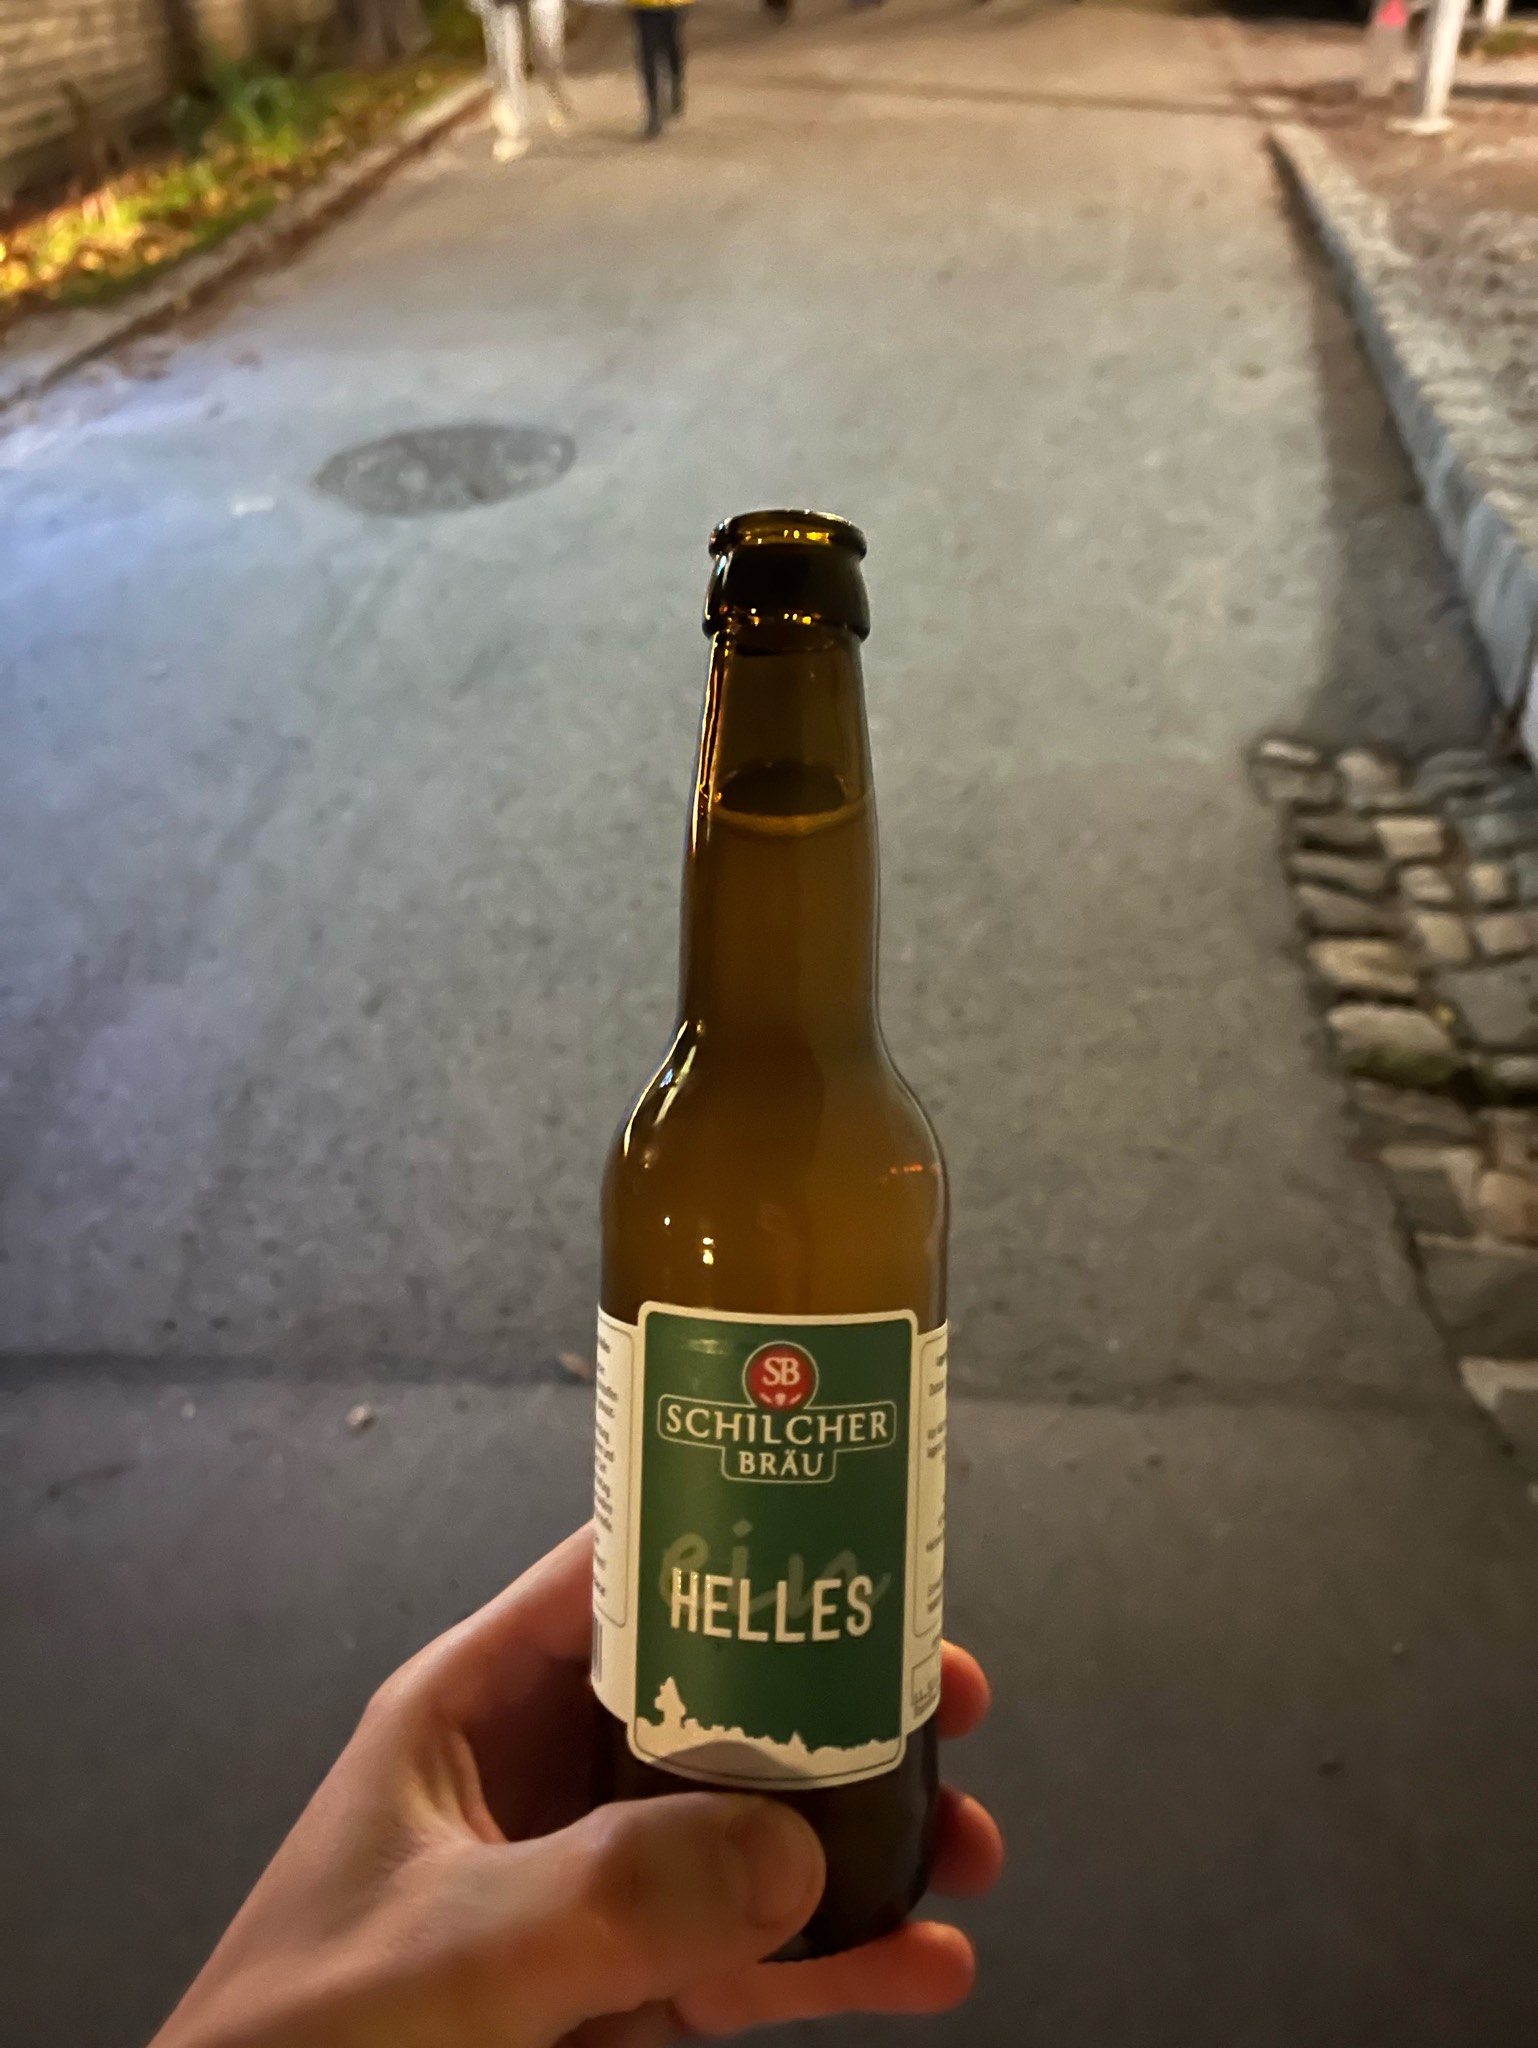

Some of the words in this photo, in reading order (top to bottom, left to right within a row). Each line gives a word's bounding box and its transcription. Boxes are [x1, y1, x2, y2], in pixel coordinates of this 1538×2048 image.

[762, 1356, 800, 1386] SB
[666, 1403, 888, 1445] SCHILCHER
[738, 1448, 824, 1477] BRÄU
[670, 1566, 873, 1643] HELLES
